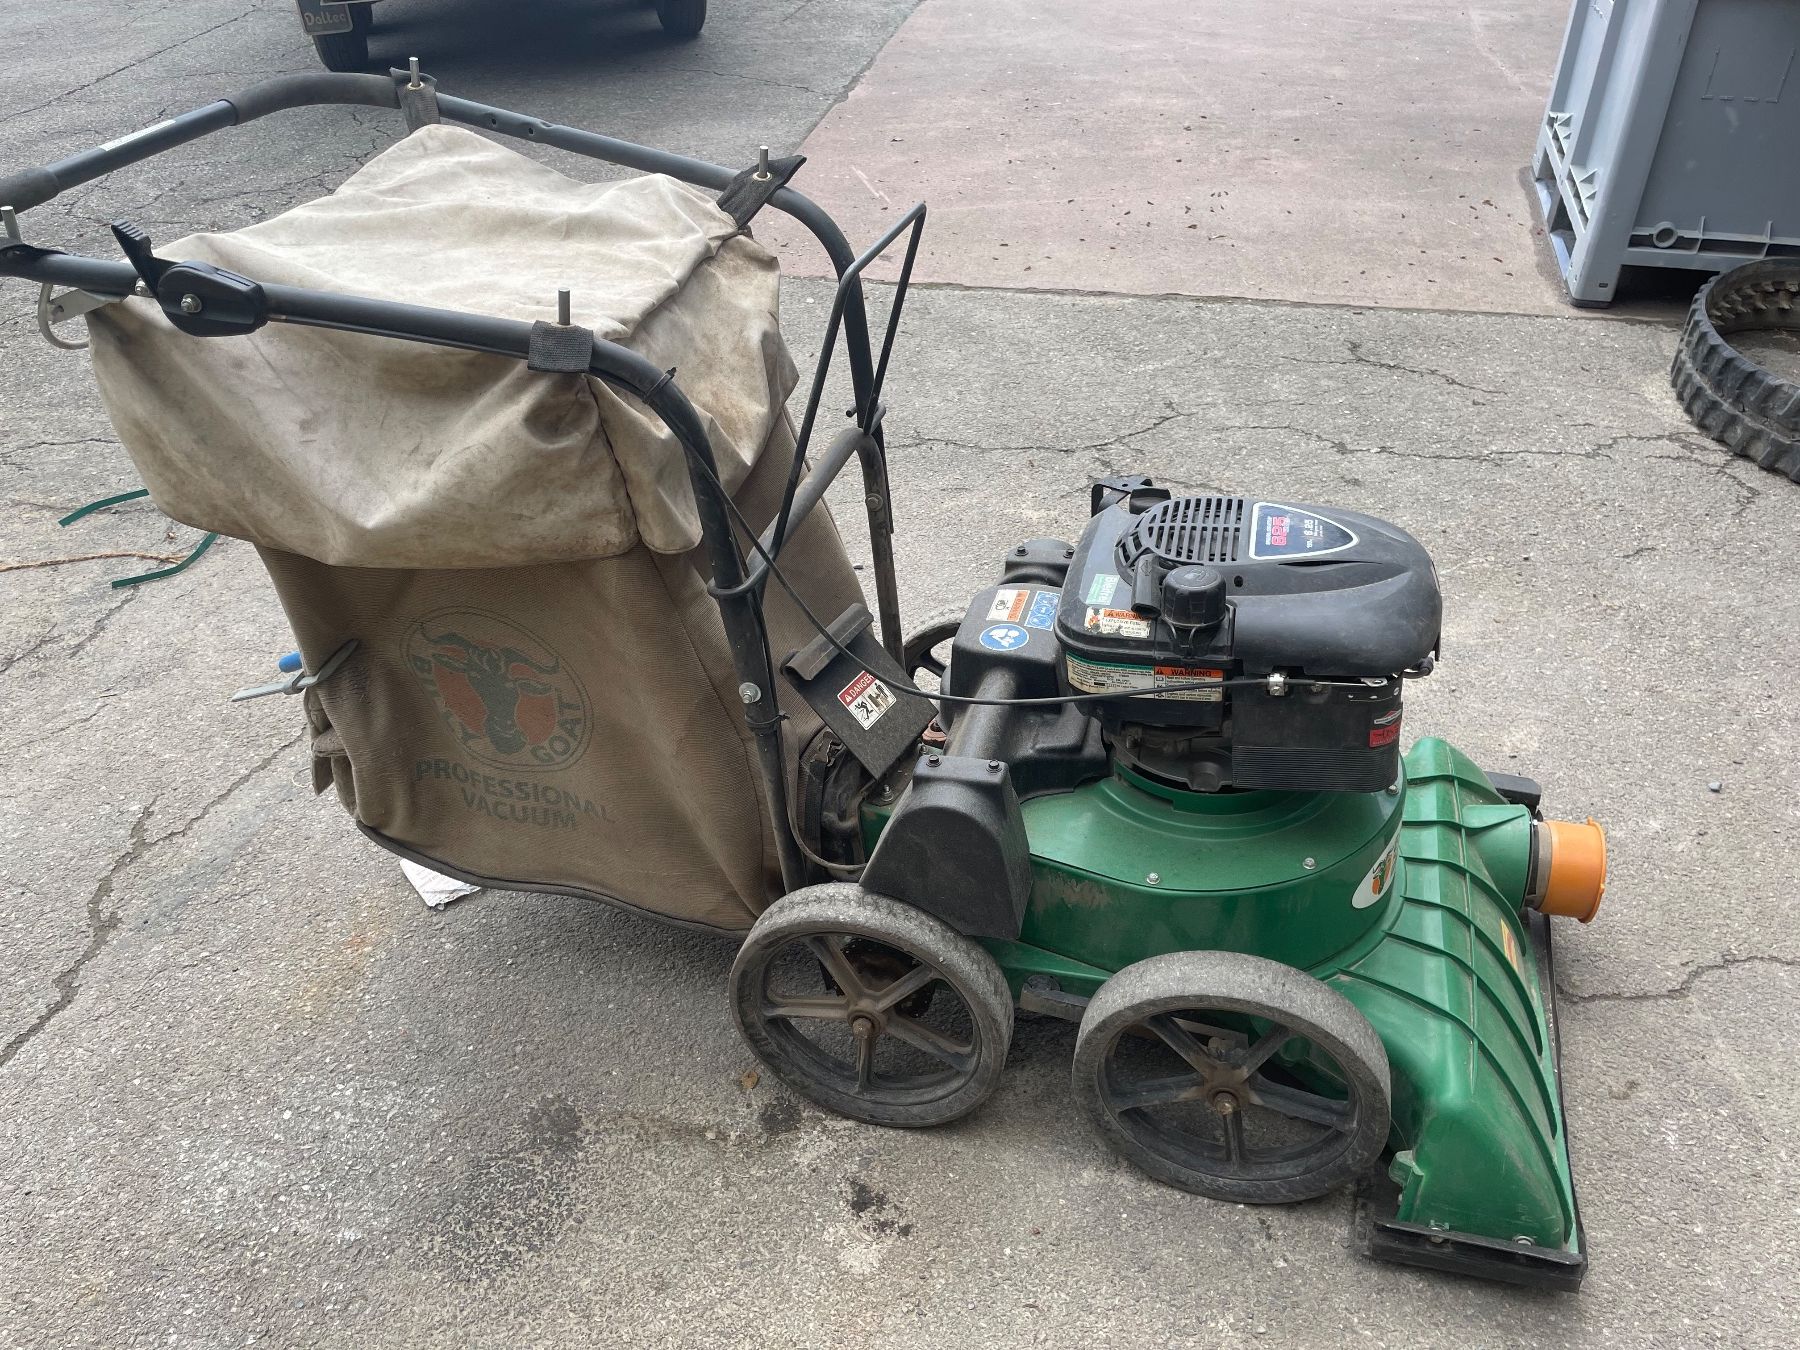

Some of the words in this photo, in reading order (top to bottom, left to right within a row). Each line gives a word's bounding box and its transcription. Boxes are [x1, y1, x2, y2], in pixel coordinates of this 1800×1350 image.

[850, 673, 876, 698] DANGER
[1171, 668, 1212, 677] WARNING
[529, 688, 581, 763] GOAT
[414, 758, 616, 824] PROFESSIONAL
[460, 786, 578, 830] VACUUM
